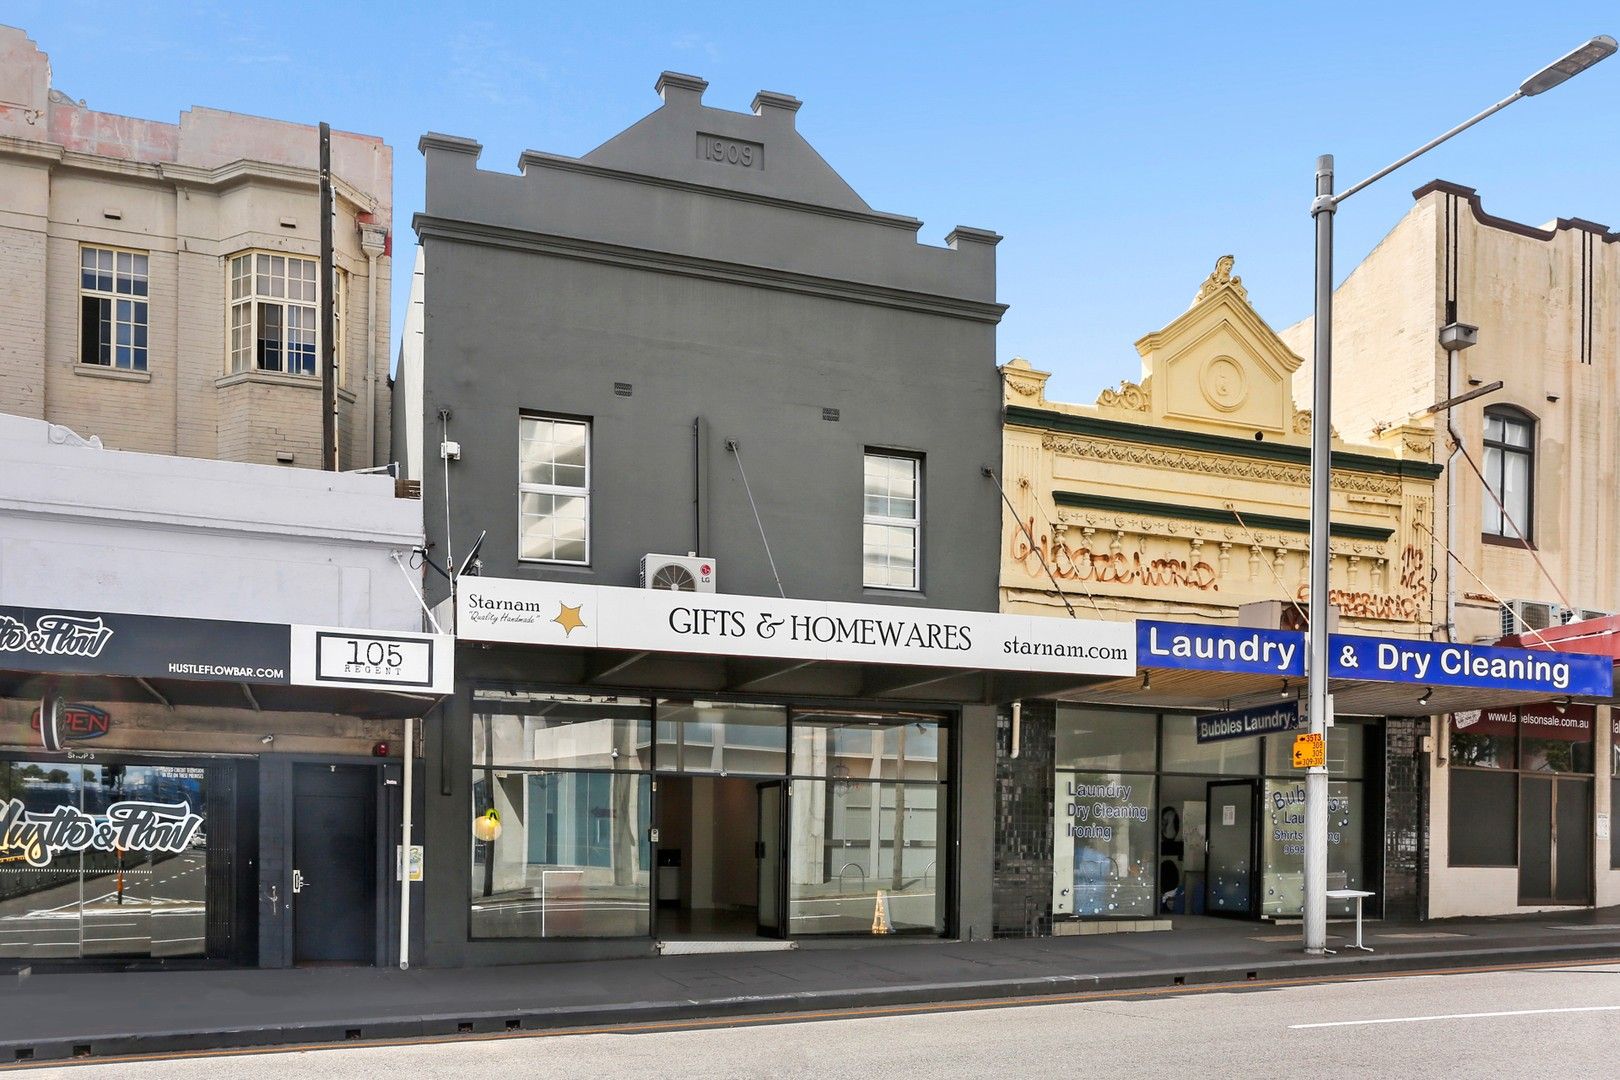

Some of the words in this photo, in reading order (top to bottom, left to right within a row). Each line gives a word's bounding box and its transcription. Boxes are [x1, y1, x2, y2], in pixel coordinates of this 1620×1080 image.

[705, 137, 754, 167] 1909
[469, 594, 540, 612] Starnam
[669, 607, 746, 638] GIFTS
[757, 613, 785, 639] &
[791, 617, 972, 651] HOMEWARES
[347, 640, 403, 667] 105
[1003, 635, 1128, 661] starnam.com
[1149, 627, 1296, 671] Laundry
[1340, 645, 1359, 668] &
[1379, 643, 1431, 679] Dry
[1440, 648, 1569, 688] Cleaning
[168, 662, 284, 679] HUSTLEFLOWBAR.COM
[345, 664, 402, 676] REGENT
[1201, 719, 1242, 738] Bubbles
[1244, 710, 1291, 731] Laundry
[89, 752, 96, 760] 3
[1067, 781, 1131, 801] Laundry
[1272, 784, 1340, 812] Bubs
[1067, 802, 1090, 820] Dry
[1093, 801, 1148, 822] Cleaning
[106, 801, 205, 853] Flow
[1067, 822, 1112, 842] Ironing
[1274, 829, 1304, 842] Shirts
